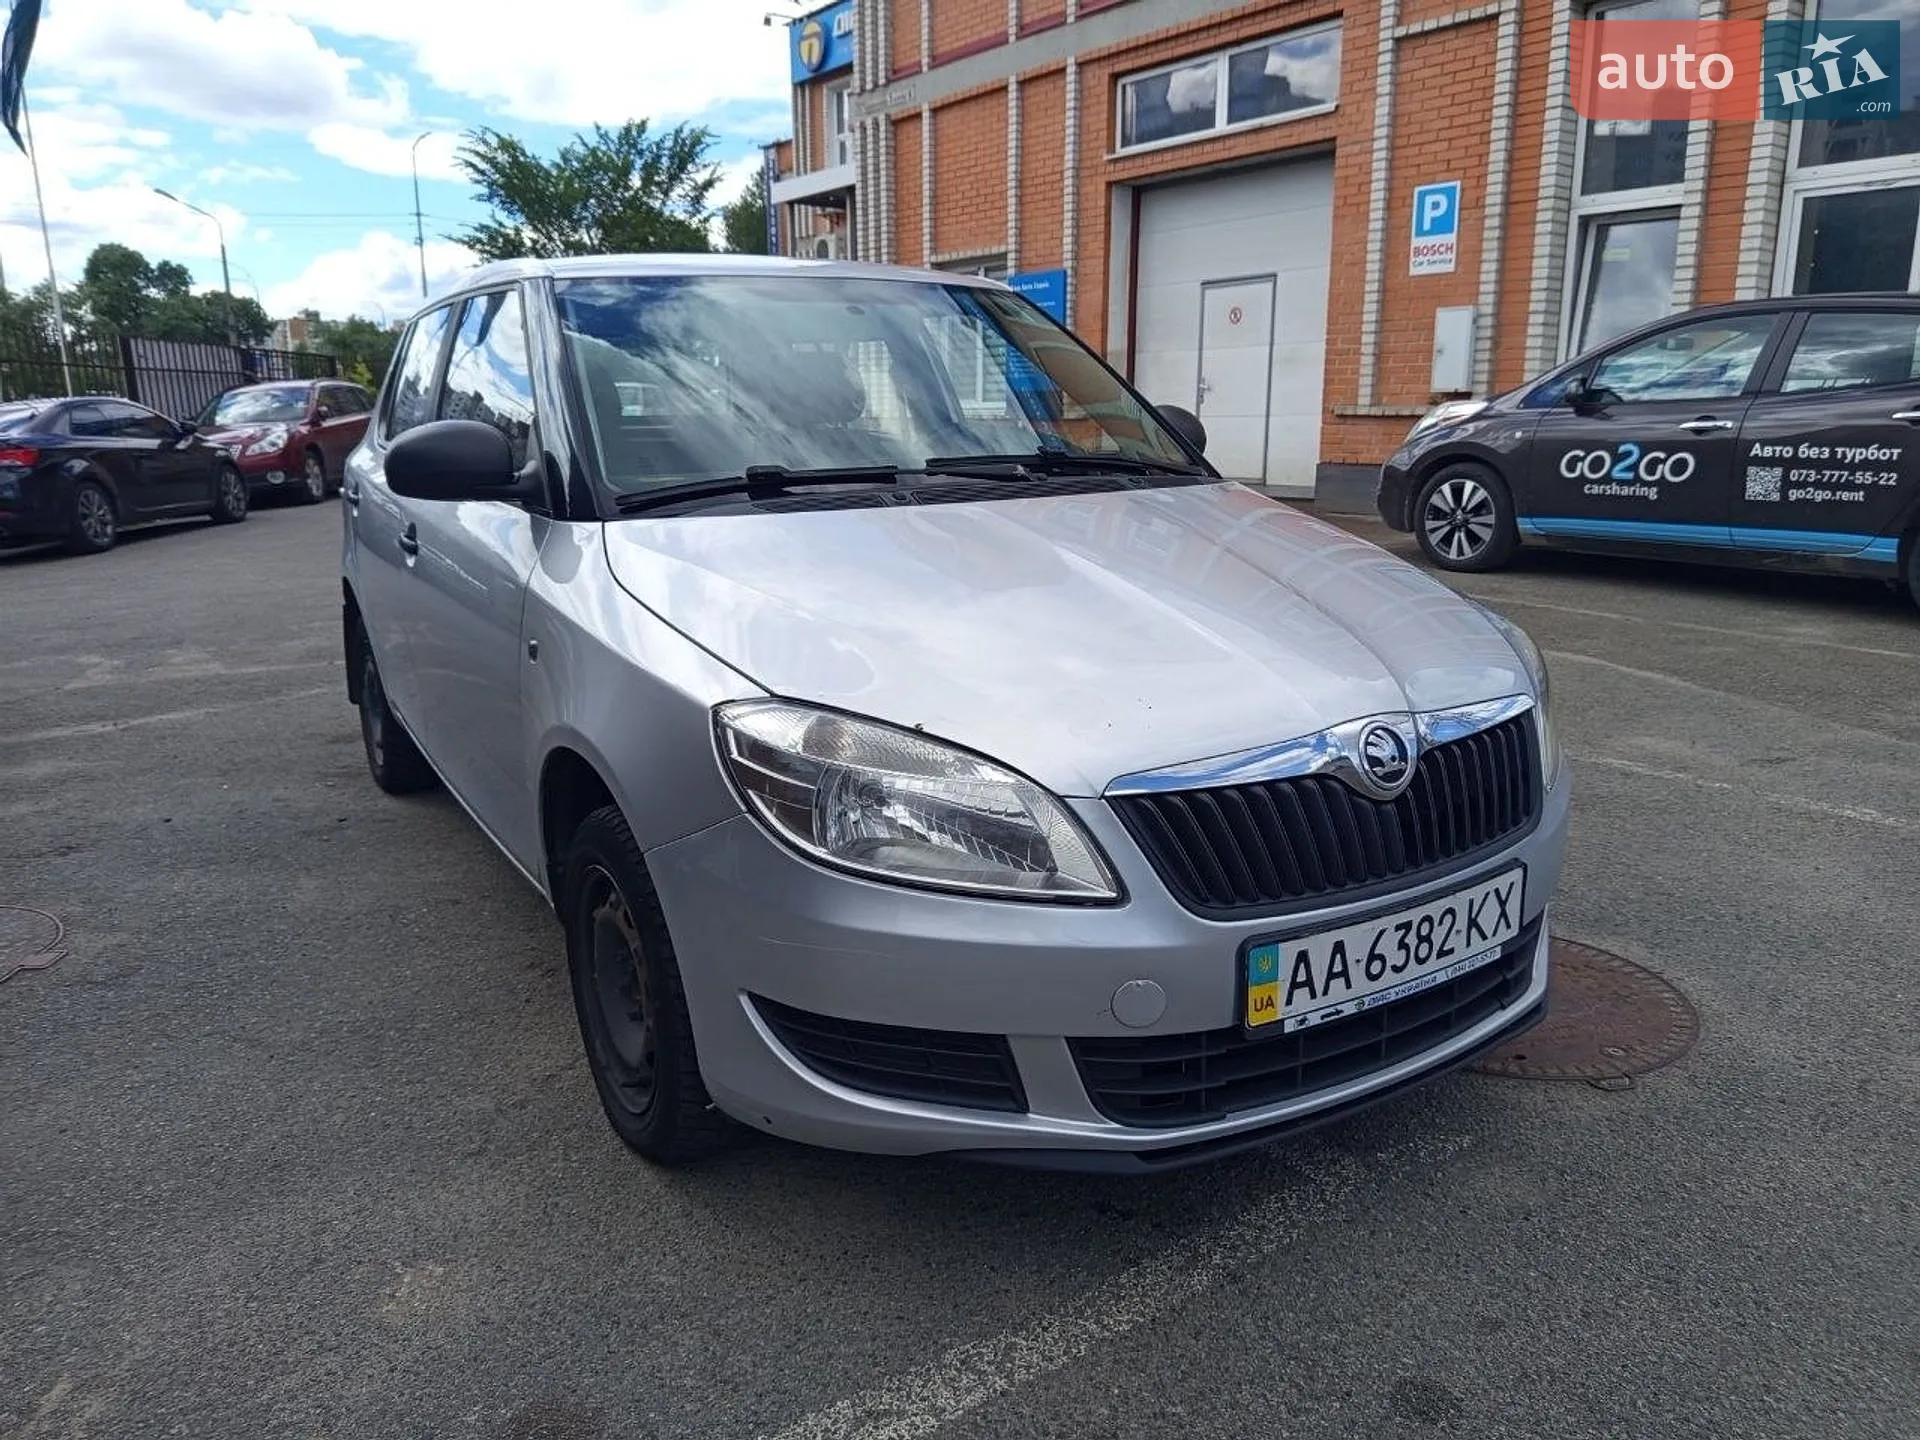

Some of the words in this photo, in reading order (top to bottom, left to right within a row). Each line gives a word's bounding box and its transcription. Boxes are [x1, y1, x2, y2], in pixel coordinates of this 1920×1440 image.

[1423, 194, 1448, 231] P
[1413, 243, 1453, 258] BOSCH
[1749, 442, 1793, 460] Авто
[1797, 443, 1830, 460] без
[1833, 446, 1902, 463] турбот
[1560, 442, 1696, 483] GO2GO
[1789, 469, 1898, 486] 073-777-55-22
[1584, 483, 1659, 500] carsharing
[1788, 487, 1865, 503] go2go.rent
[1253, 996, 1275, 1013] UA
